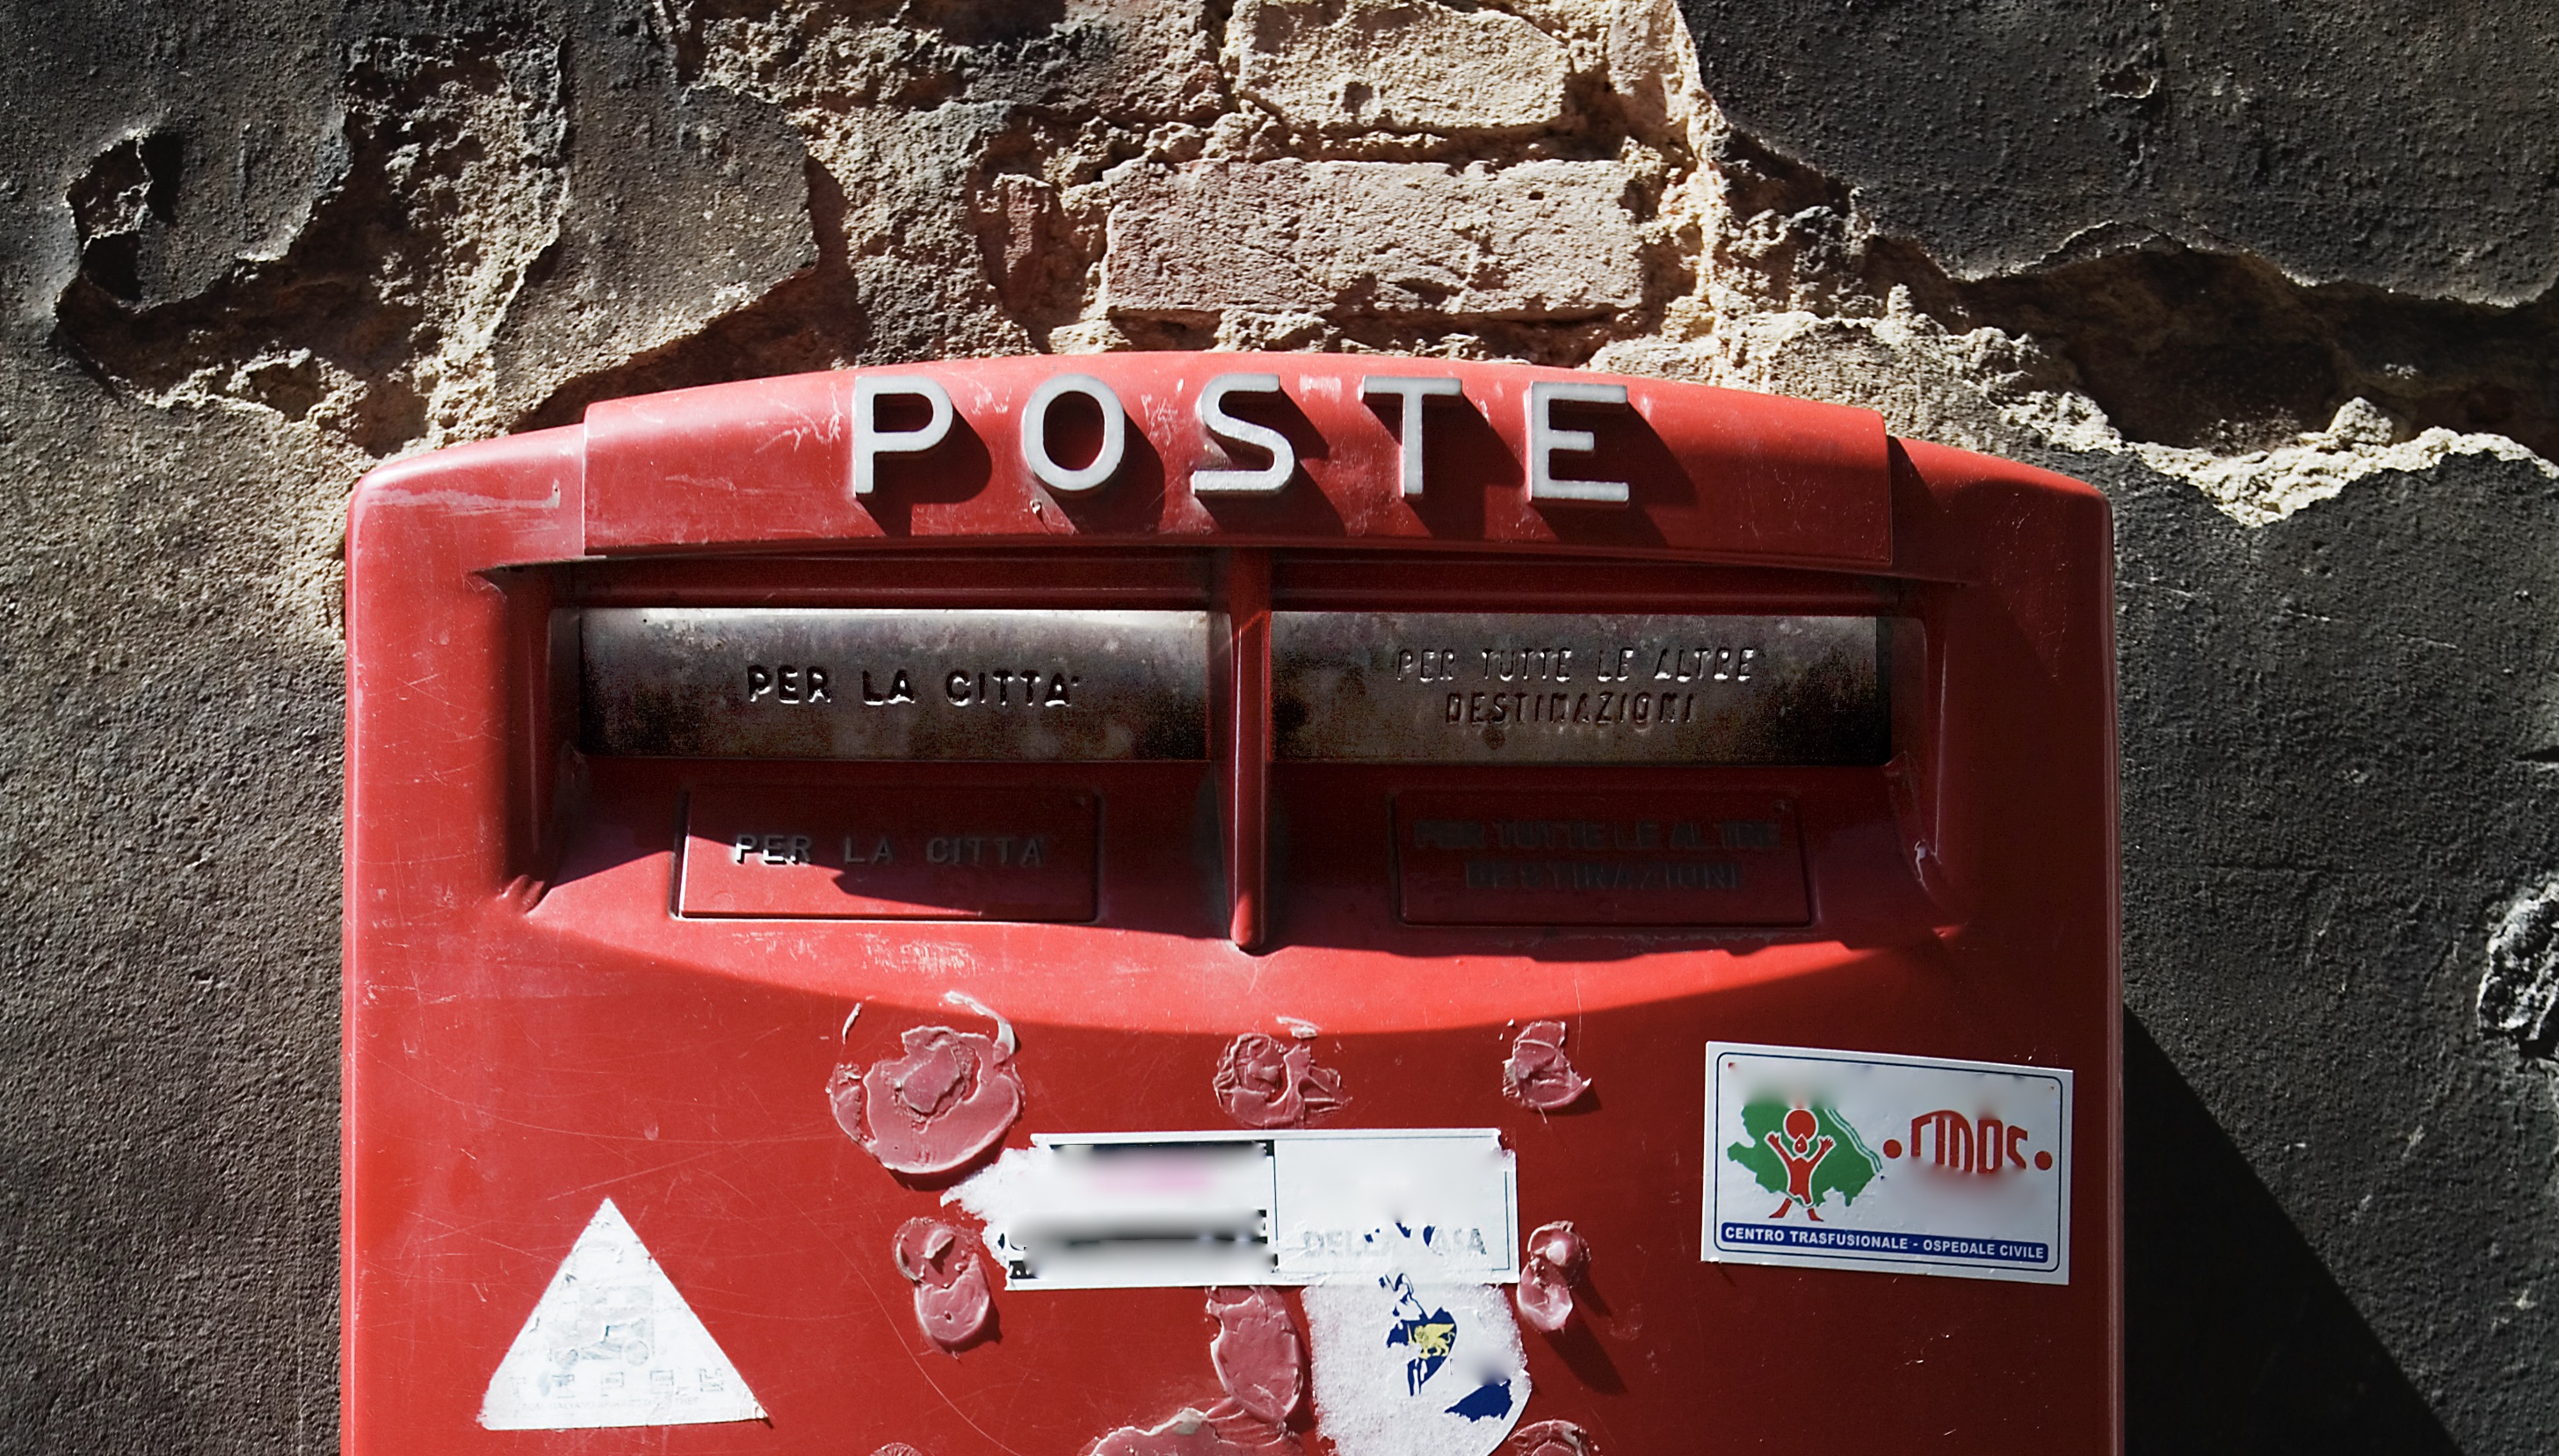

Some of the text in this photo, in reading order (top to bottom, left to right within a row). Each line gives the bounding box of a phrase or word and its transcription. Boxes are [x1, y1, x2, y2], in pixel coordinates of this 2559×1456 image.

[852, 373, 1630, 503] POSTE
[1396, 646, 1758, 683] PER TUTTE LE ALTRE
[747, 665, 832, 705] PER
[861, 668, 916, 706] LA
[1445, 691, 1696, 726] DESTINAZIONI
[735, 833, 813, 866] PER
[843, 835, 895, 866] LA
[1725, 1227, 1785, 1242] CENTRO
[1789, 1230, 1909, 1250] TRASFUSIONALE
[1923, 1240, 1996, 1256] OSPEDALE
[1999, 1244, 2044, 1259] CIVILE
